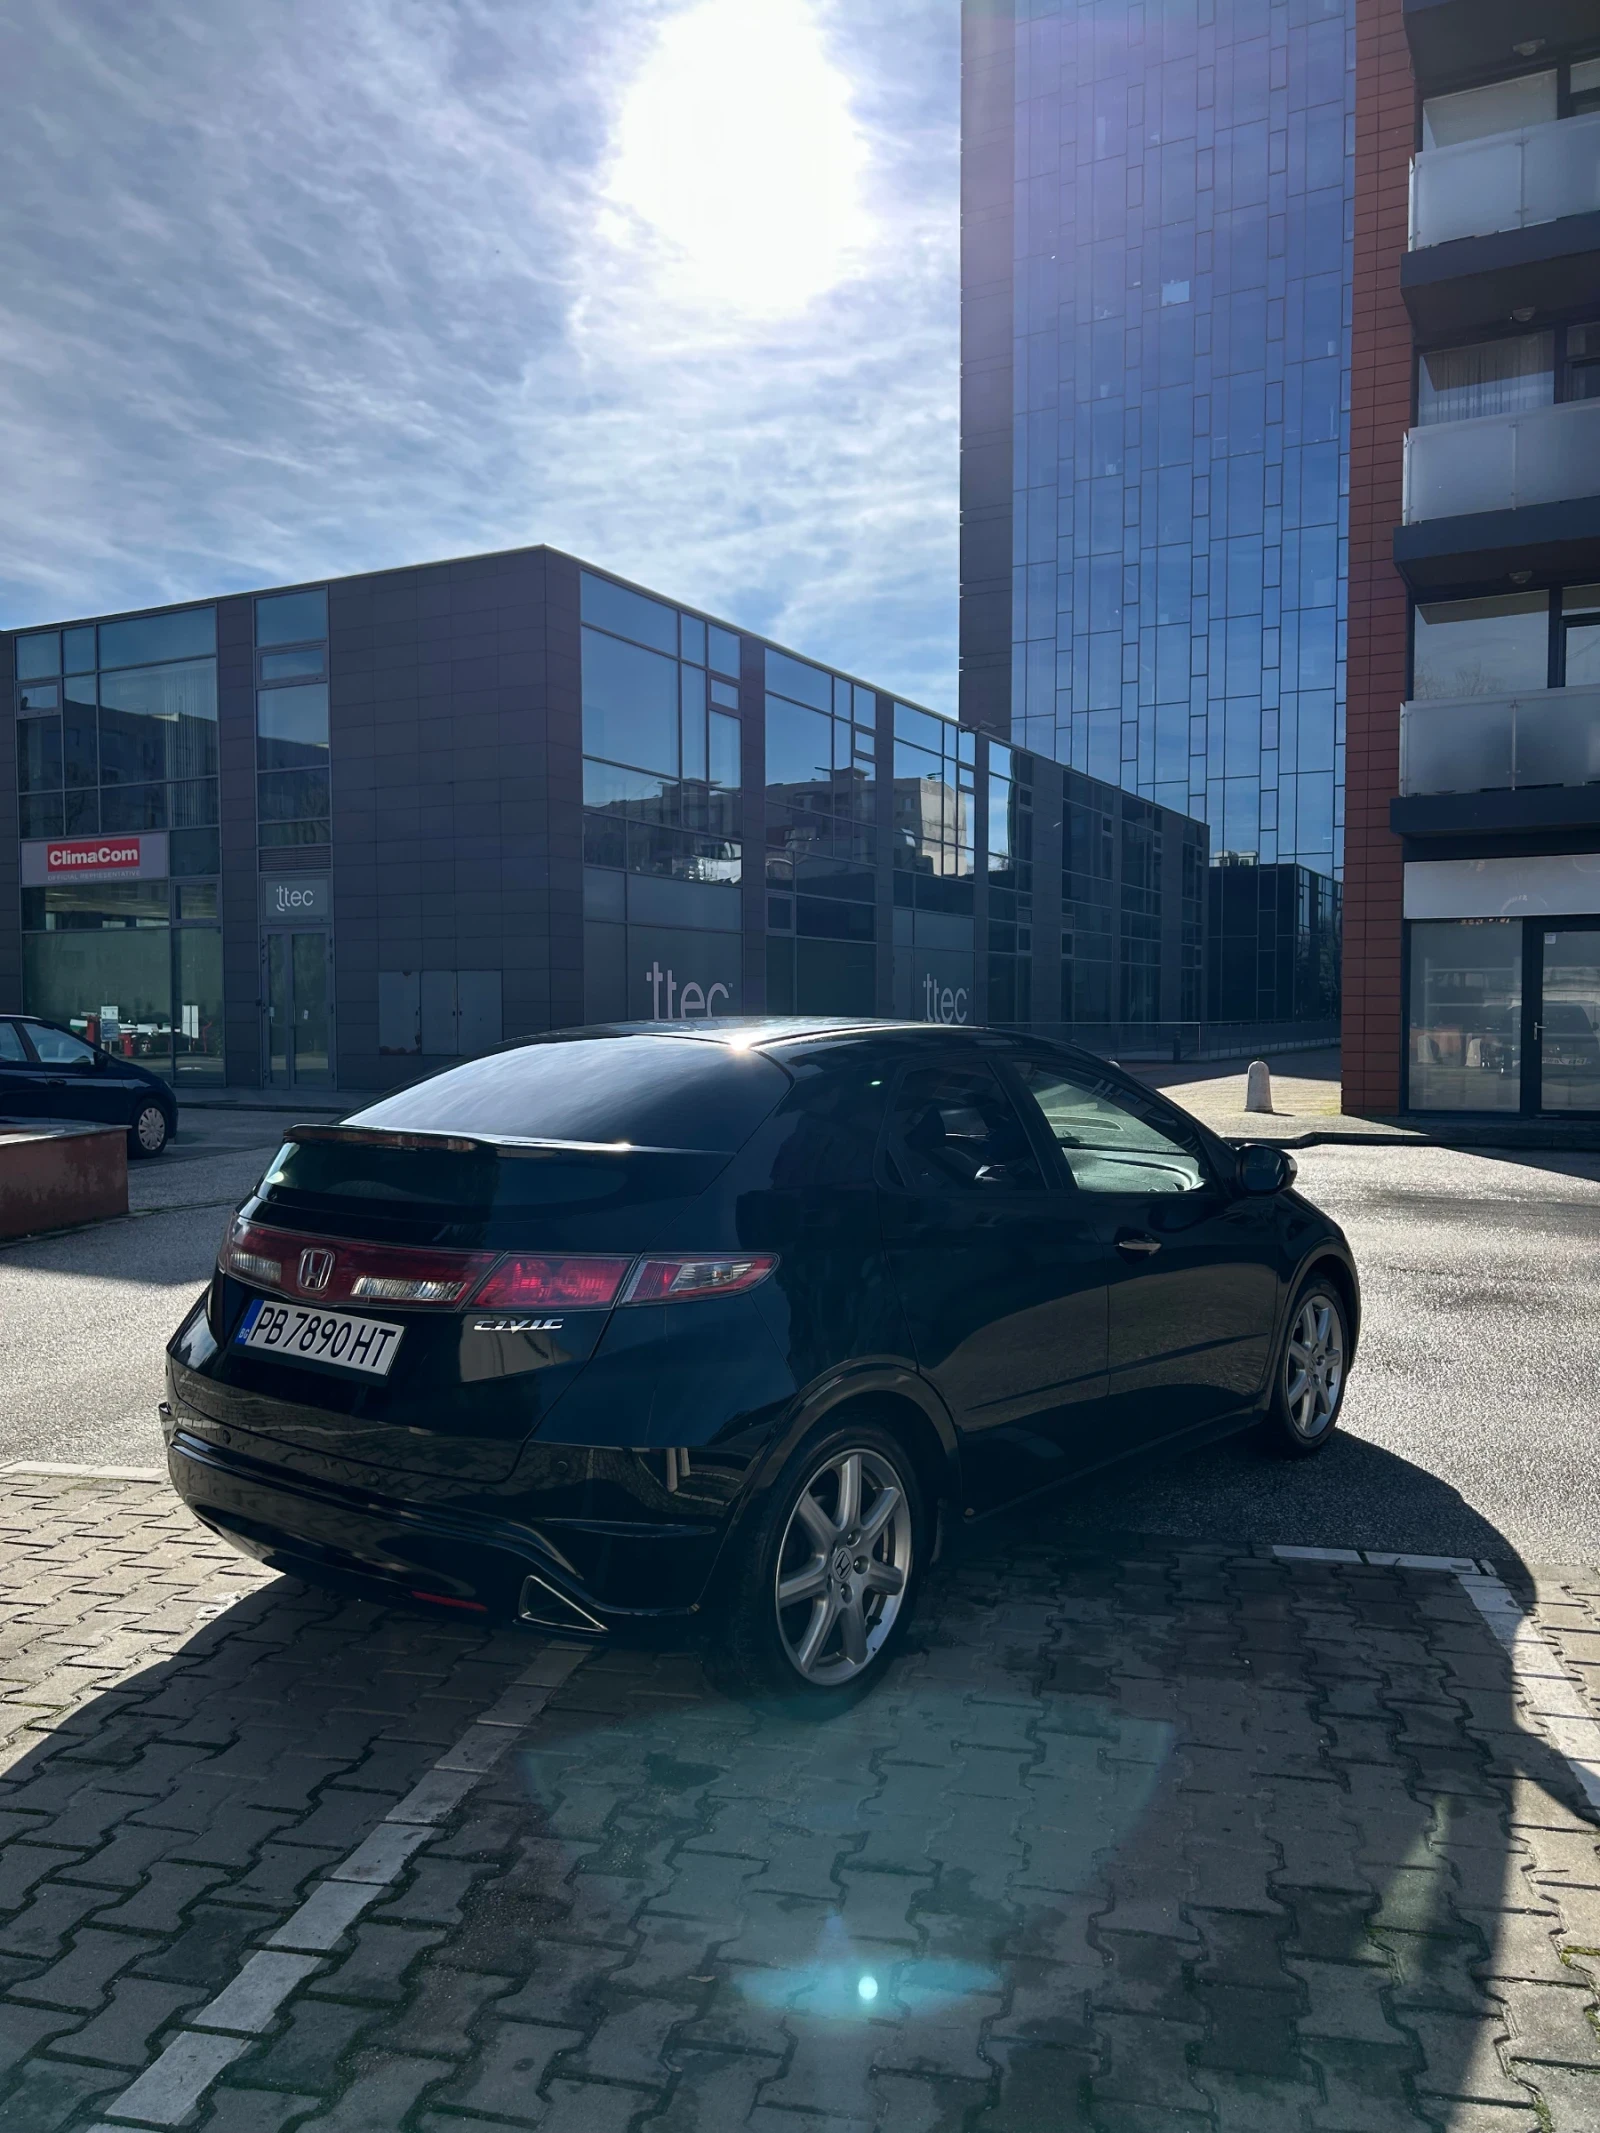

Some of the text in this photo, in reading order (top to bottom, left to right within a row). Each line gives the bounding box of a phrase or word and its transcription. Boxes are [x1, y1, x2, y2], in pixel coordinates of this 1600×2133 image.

[49, 847, 138, 866] ClimaCom
[238, 1327, 250, 1340] BG
[474, 1318, 564, 1334] CIVIC
